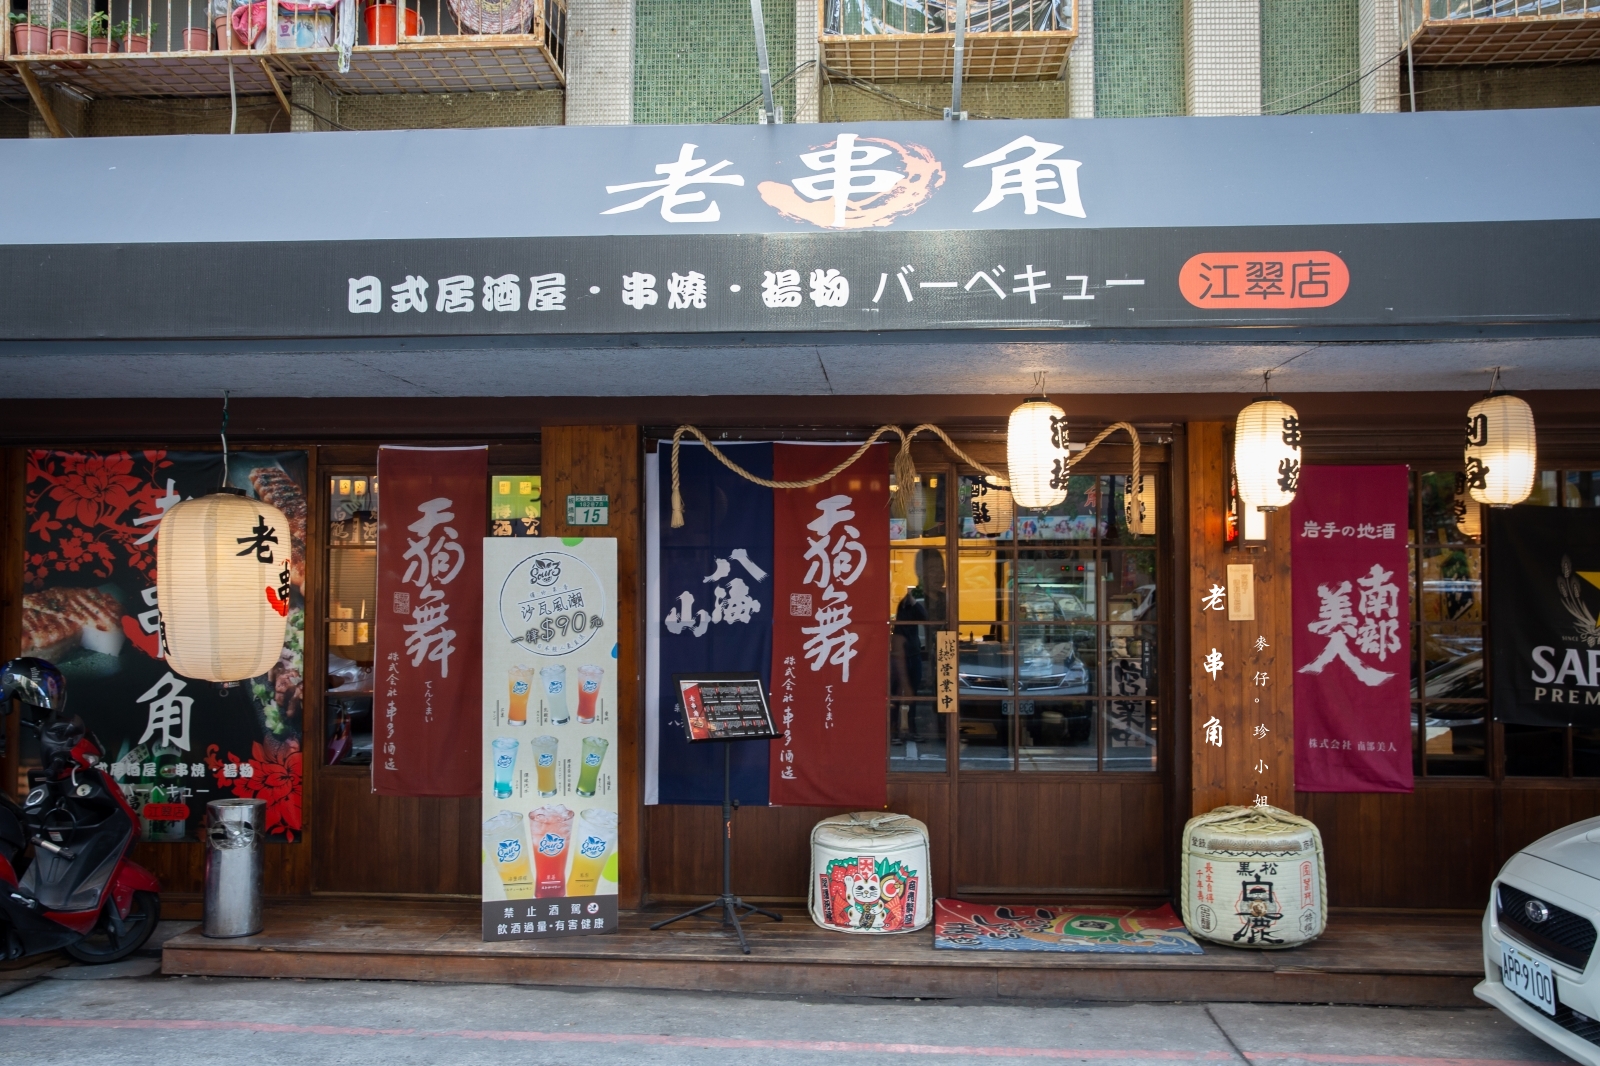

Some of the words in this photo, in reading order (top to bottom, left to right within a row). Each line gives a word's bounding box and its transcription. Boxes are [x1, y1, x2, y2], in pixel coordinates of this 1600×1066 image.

[599, 132, 1087, 228] 老串角
[871, 264, 1146, 305] バーベキュー
[1199, 259, 1331, 301] 江翠店
[583, 508, 601, 523] 15
[1300, 520, 1396, 540] 岩手の地酒
[1308, 738, 1353, 752] 株式会社
[1356, 741, 1398, 753] 南部美人
[503, 902, 582, 919] 禁止酒駕
